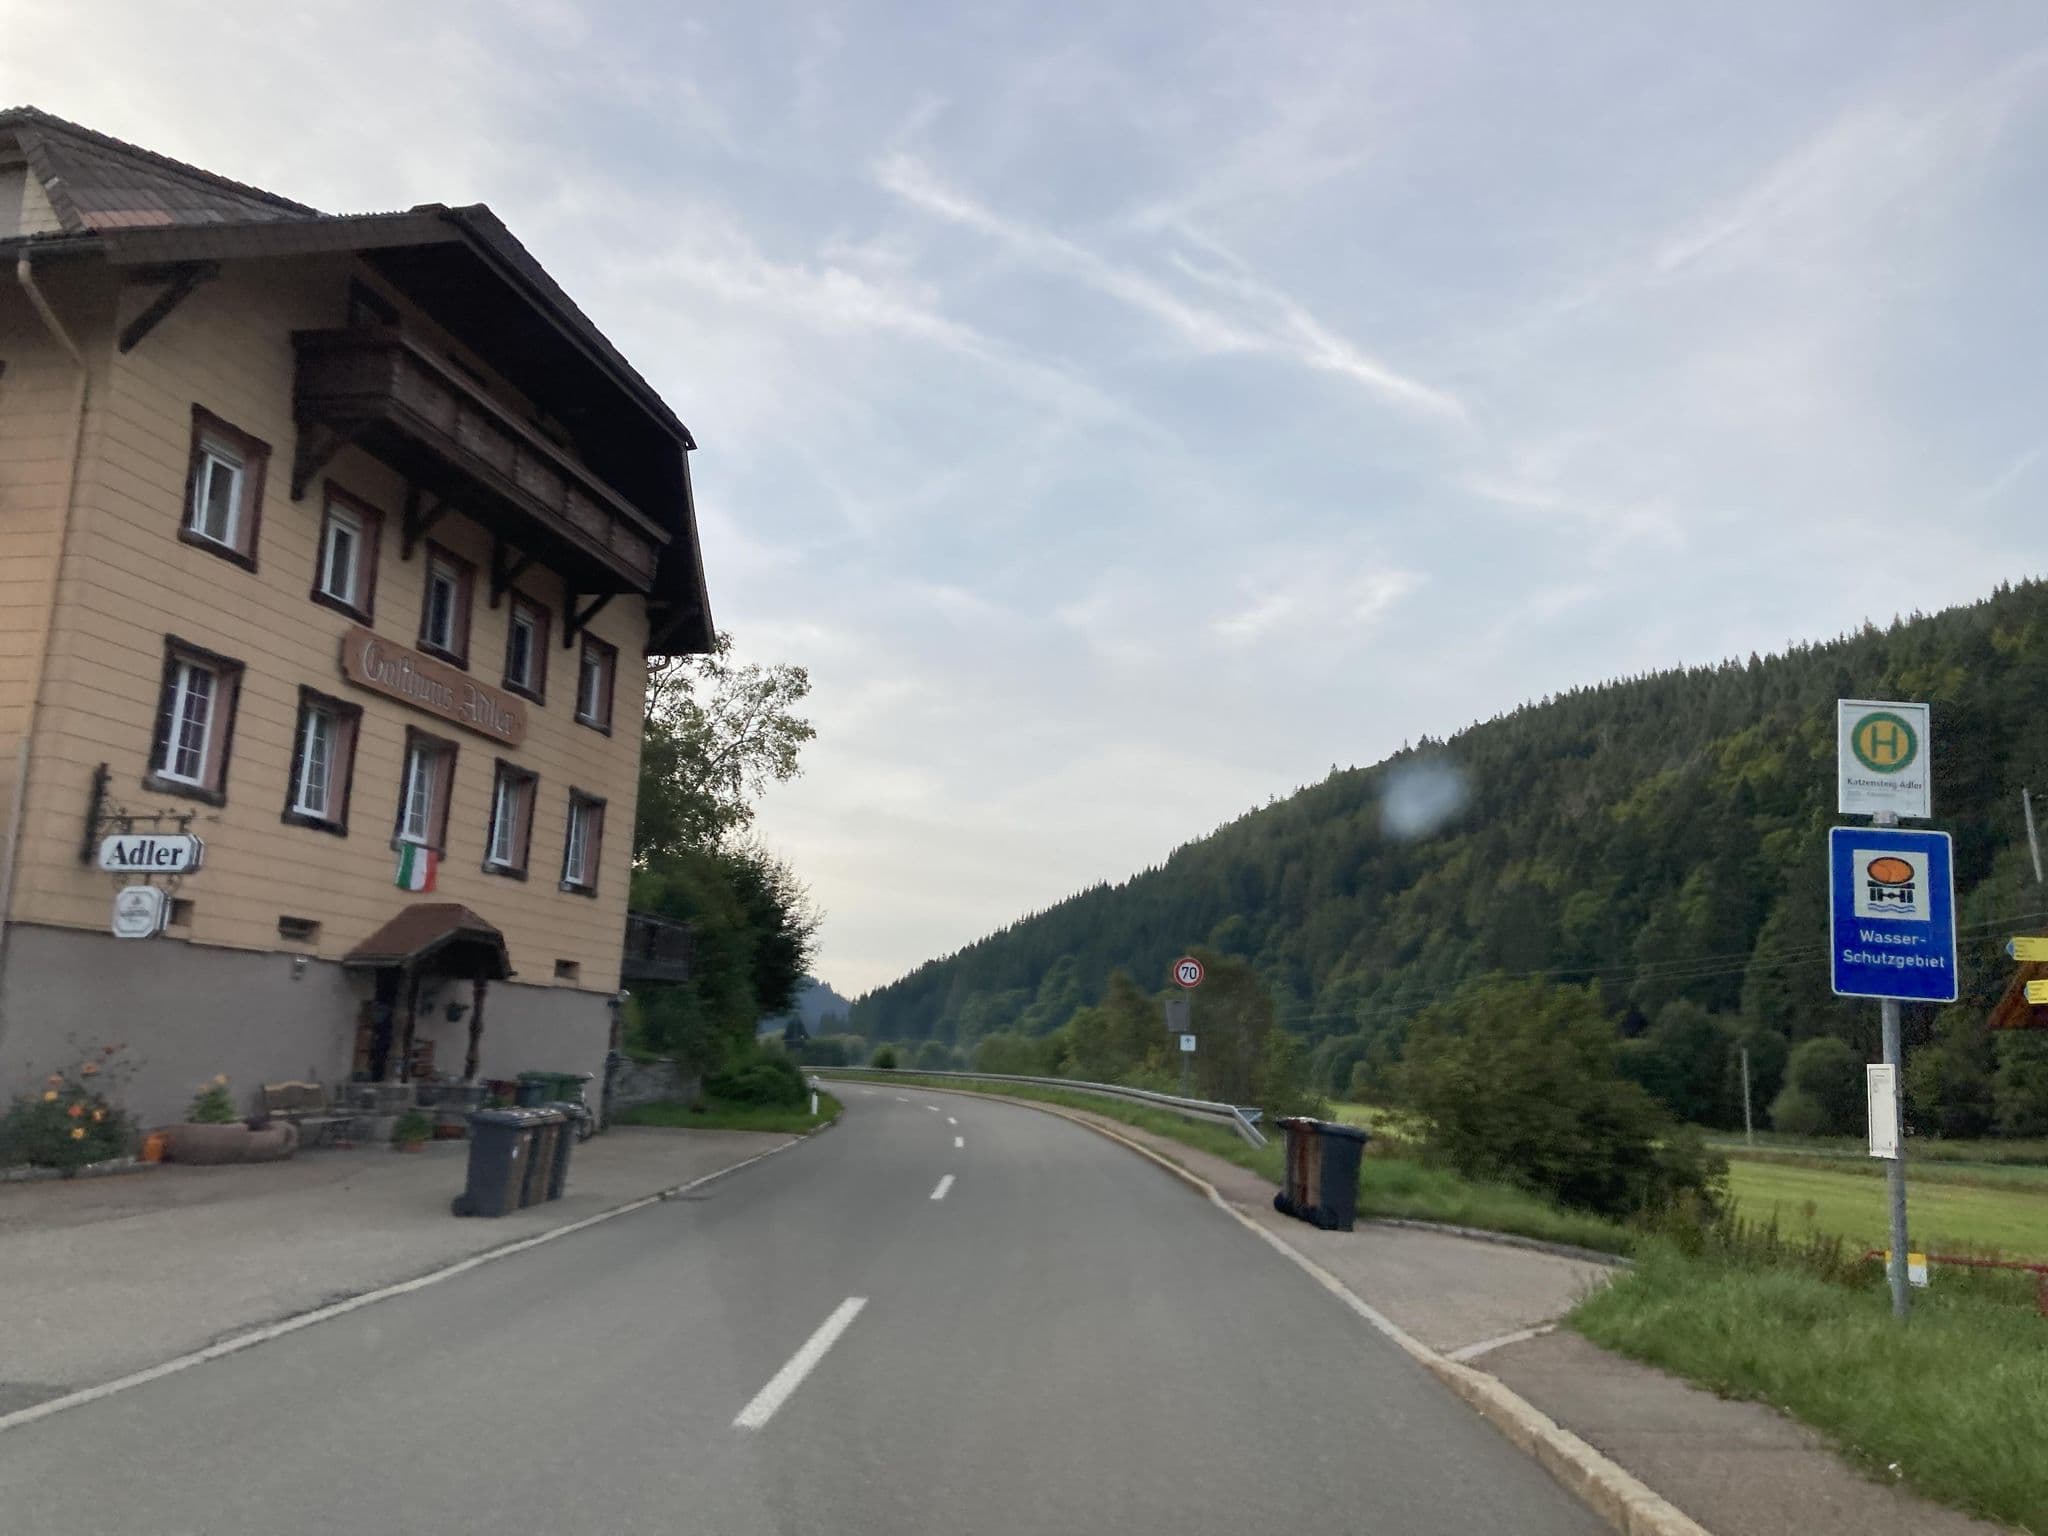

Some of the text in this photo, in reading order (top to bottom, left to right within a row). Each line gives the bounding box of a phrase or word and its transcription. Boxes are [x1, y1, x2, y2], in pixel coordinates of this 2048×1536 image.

[1871, 725, 1898, 759] H
[106, 840, 183, 866] Adler
[1860, 929, 1926, 945] Wasser-
[1843, 949, 1945, 969] Schutzgebiet
[1181, 966, 1197, 980] 70
